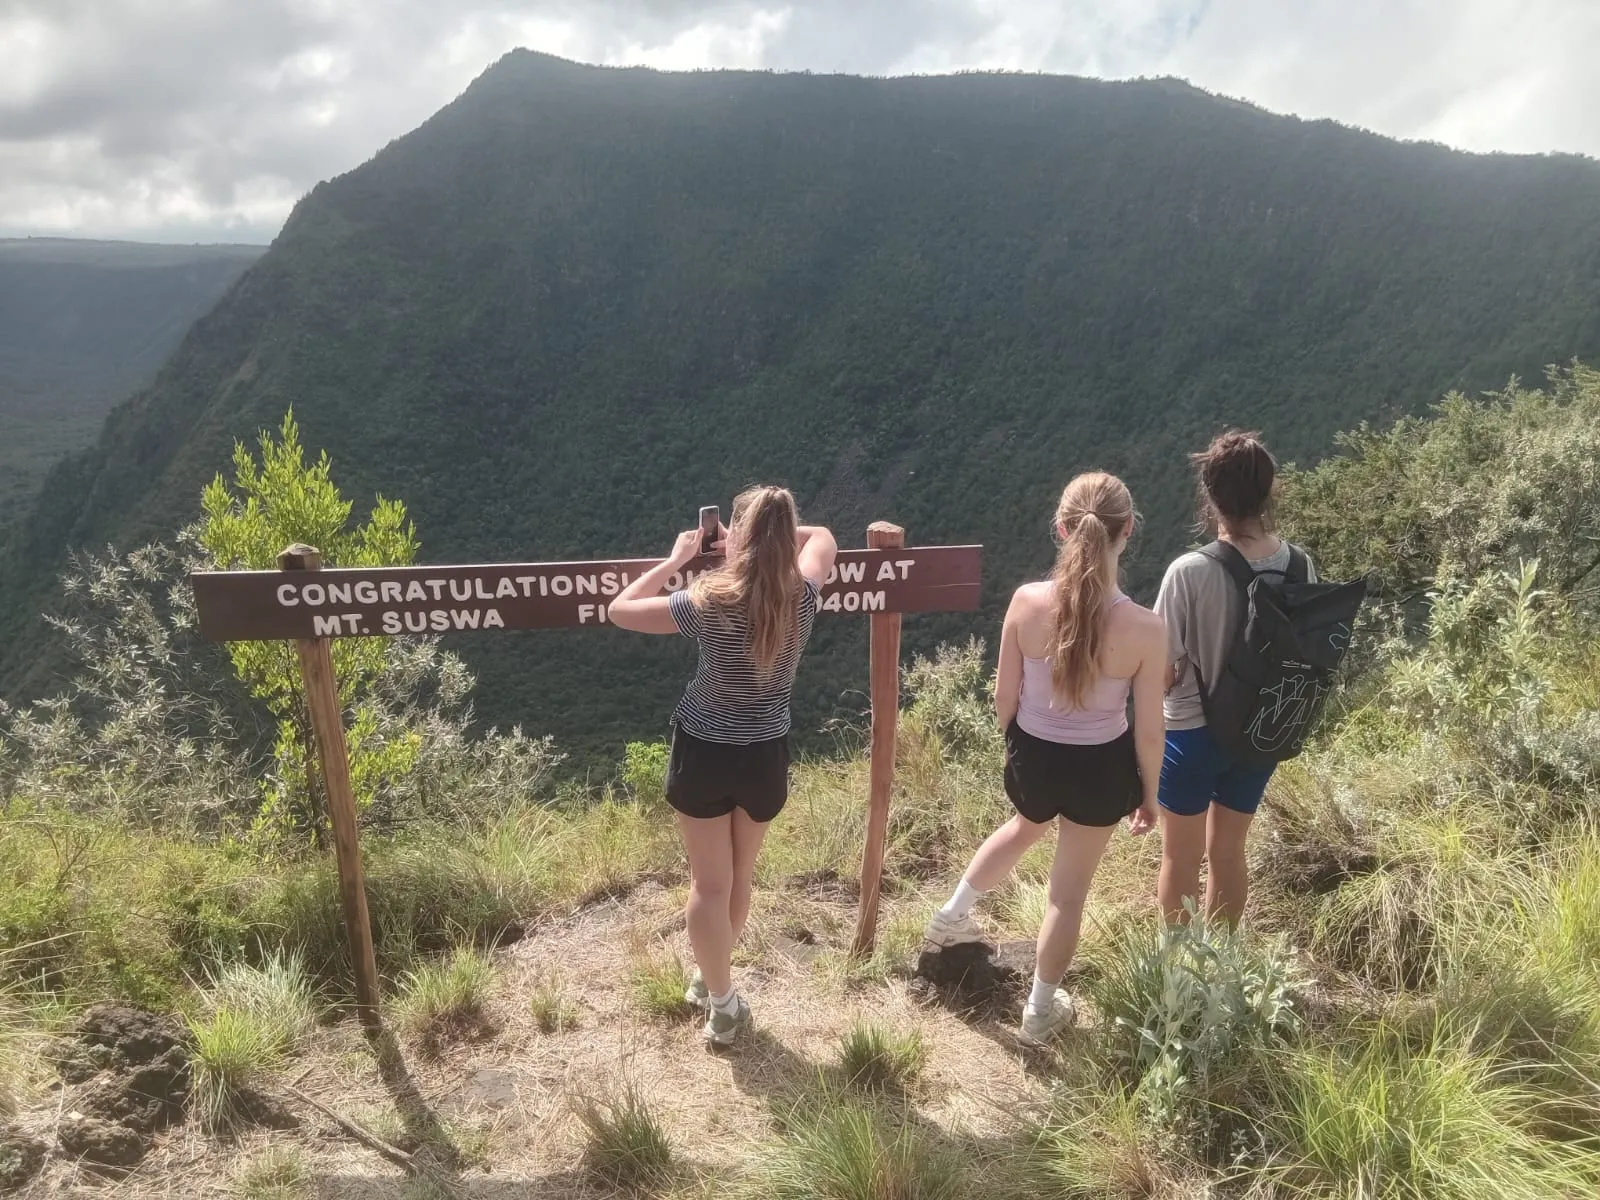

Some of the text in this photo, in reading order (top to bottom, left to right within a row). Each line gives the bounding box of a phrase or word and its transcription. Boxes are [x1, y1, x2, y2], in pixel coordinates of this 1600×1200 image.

[876, 559, 915, 581] AT
[313, 613, 370, 636] MT.
[382, 608, 505, 634] SUSWA
[578, 603, 606, 624] FI
